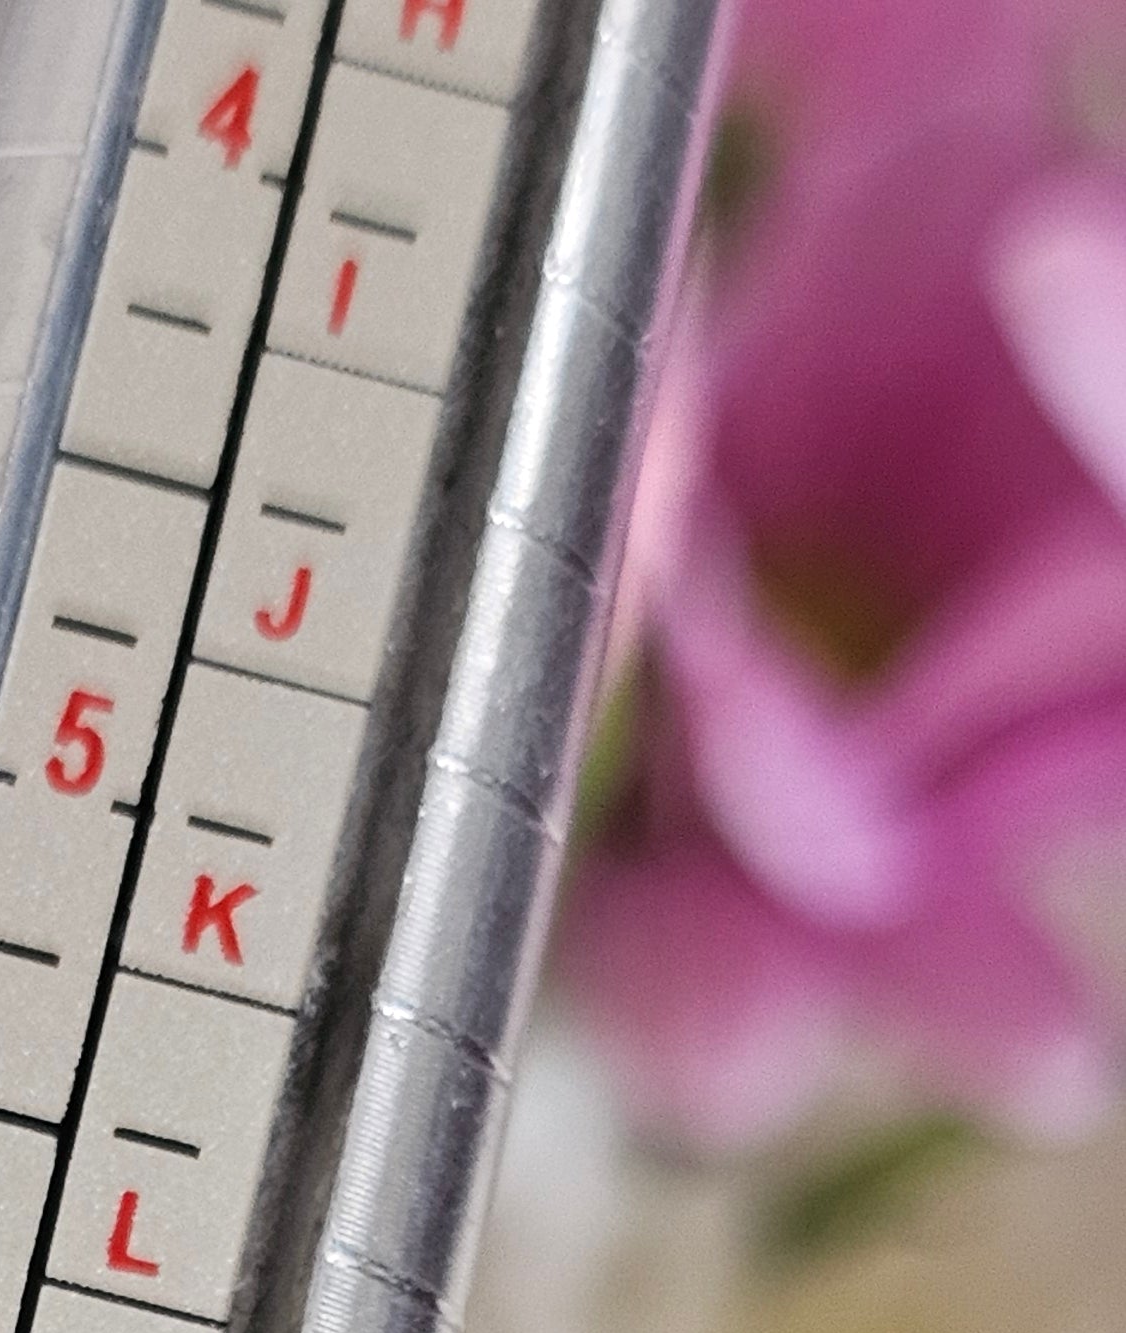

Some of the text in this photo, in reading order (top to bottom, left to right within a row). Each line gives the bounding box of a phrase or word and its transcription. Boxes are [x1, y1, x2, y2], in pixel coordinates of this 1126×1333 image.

[199, 64, 262, 168] 4
[327, 257, 359, 337] I
[254, 563, 314, 642] J
[44, 687, 114, 795] 5
[181, 872, 258, 965] K
[104, 1190, 159, 1276] L
